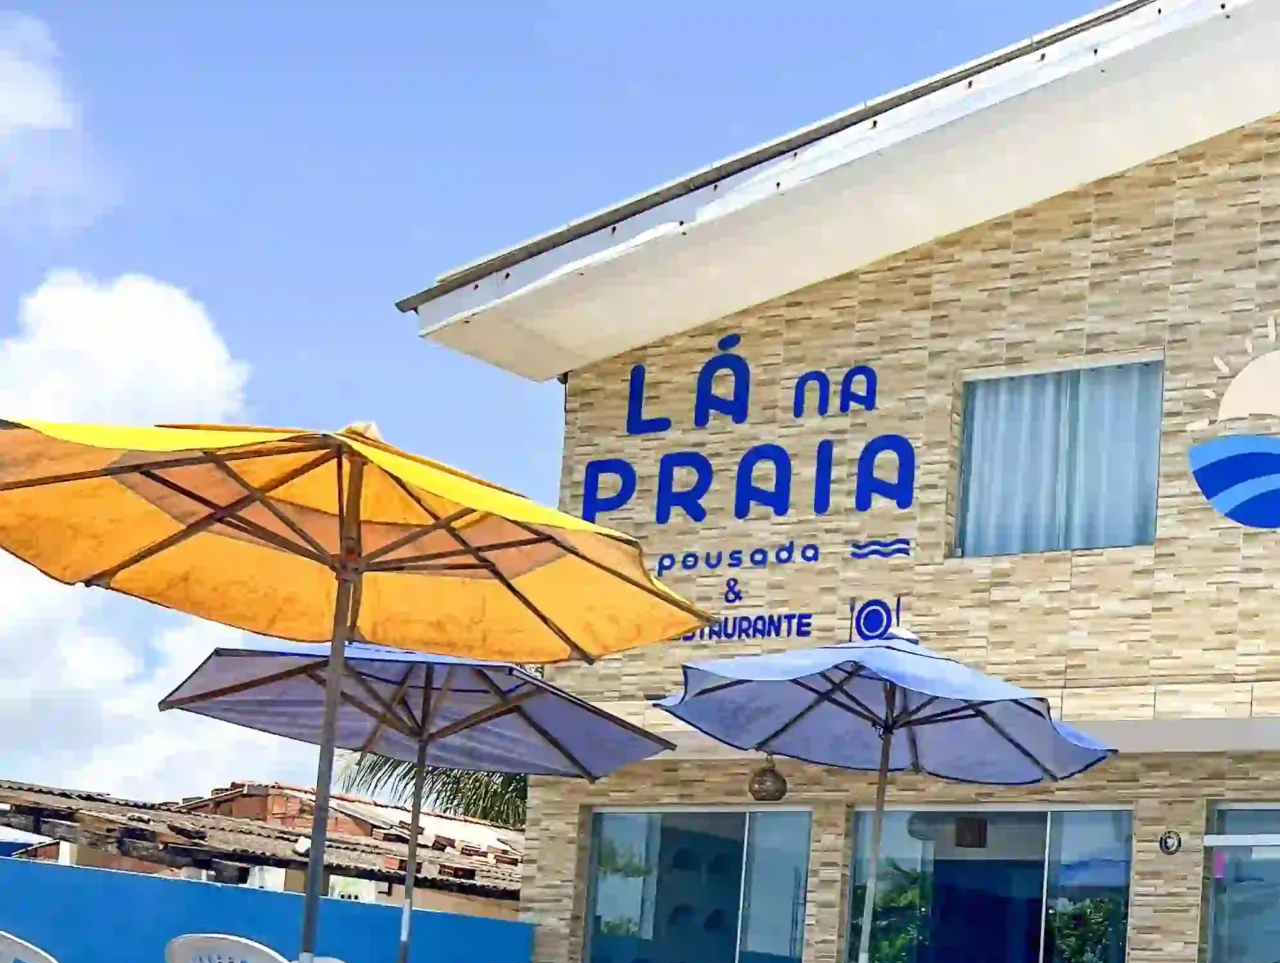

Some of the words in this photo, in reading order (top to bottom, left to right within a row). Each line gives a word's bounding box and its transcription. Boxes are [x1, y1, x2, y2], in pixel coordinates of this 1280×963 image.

[626, 333, 751, 436] LÁ
[581, 434, 916, 525] PRAIA
[657, 541, 820, 577] pousada
[724, 578, 743, 604] &
